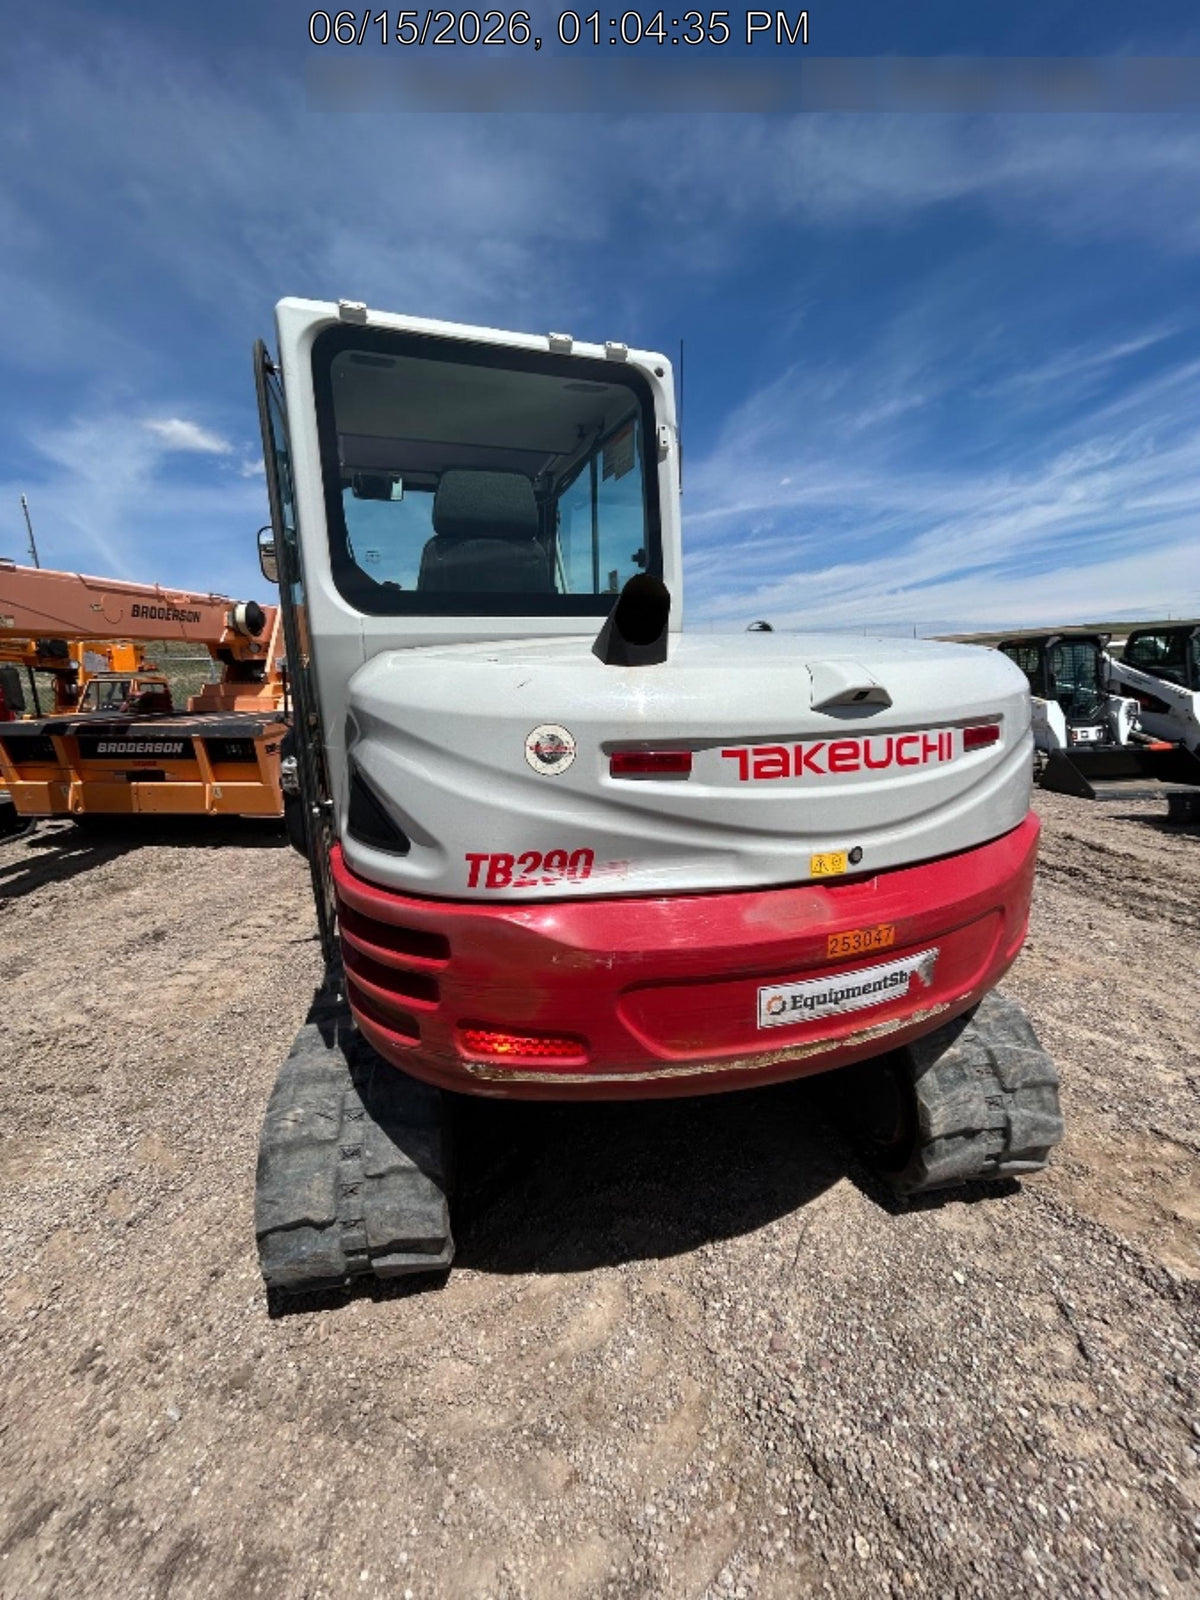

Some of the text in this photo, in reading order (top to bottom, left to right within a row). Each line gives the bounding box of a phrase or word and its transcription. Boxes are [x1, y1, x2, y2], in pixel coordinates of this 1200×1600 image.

[131, 604, 202, 623] BRODERSON
[97, 742, 184, 753] BRODERSON
[721, 733, 952, 781] TAKEUCHI
[465, 848, 595, 888] TB290
[829, 927, 893, 954] 253047
[791, 970, 910, 1011] EquipmentSh
